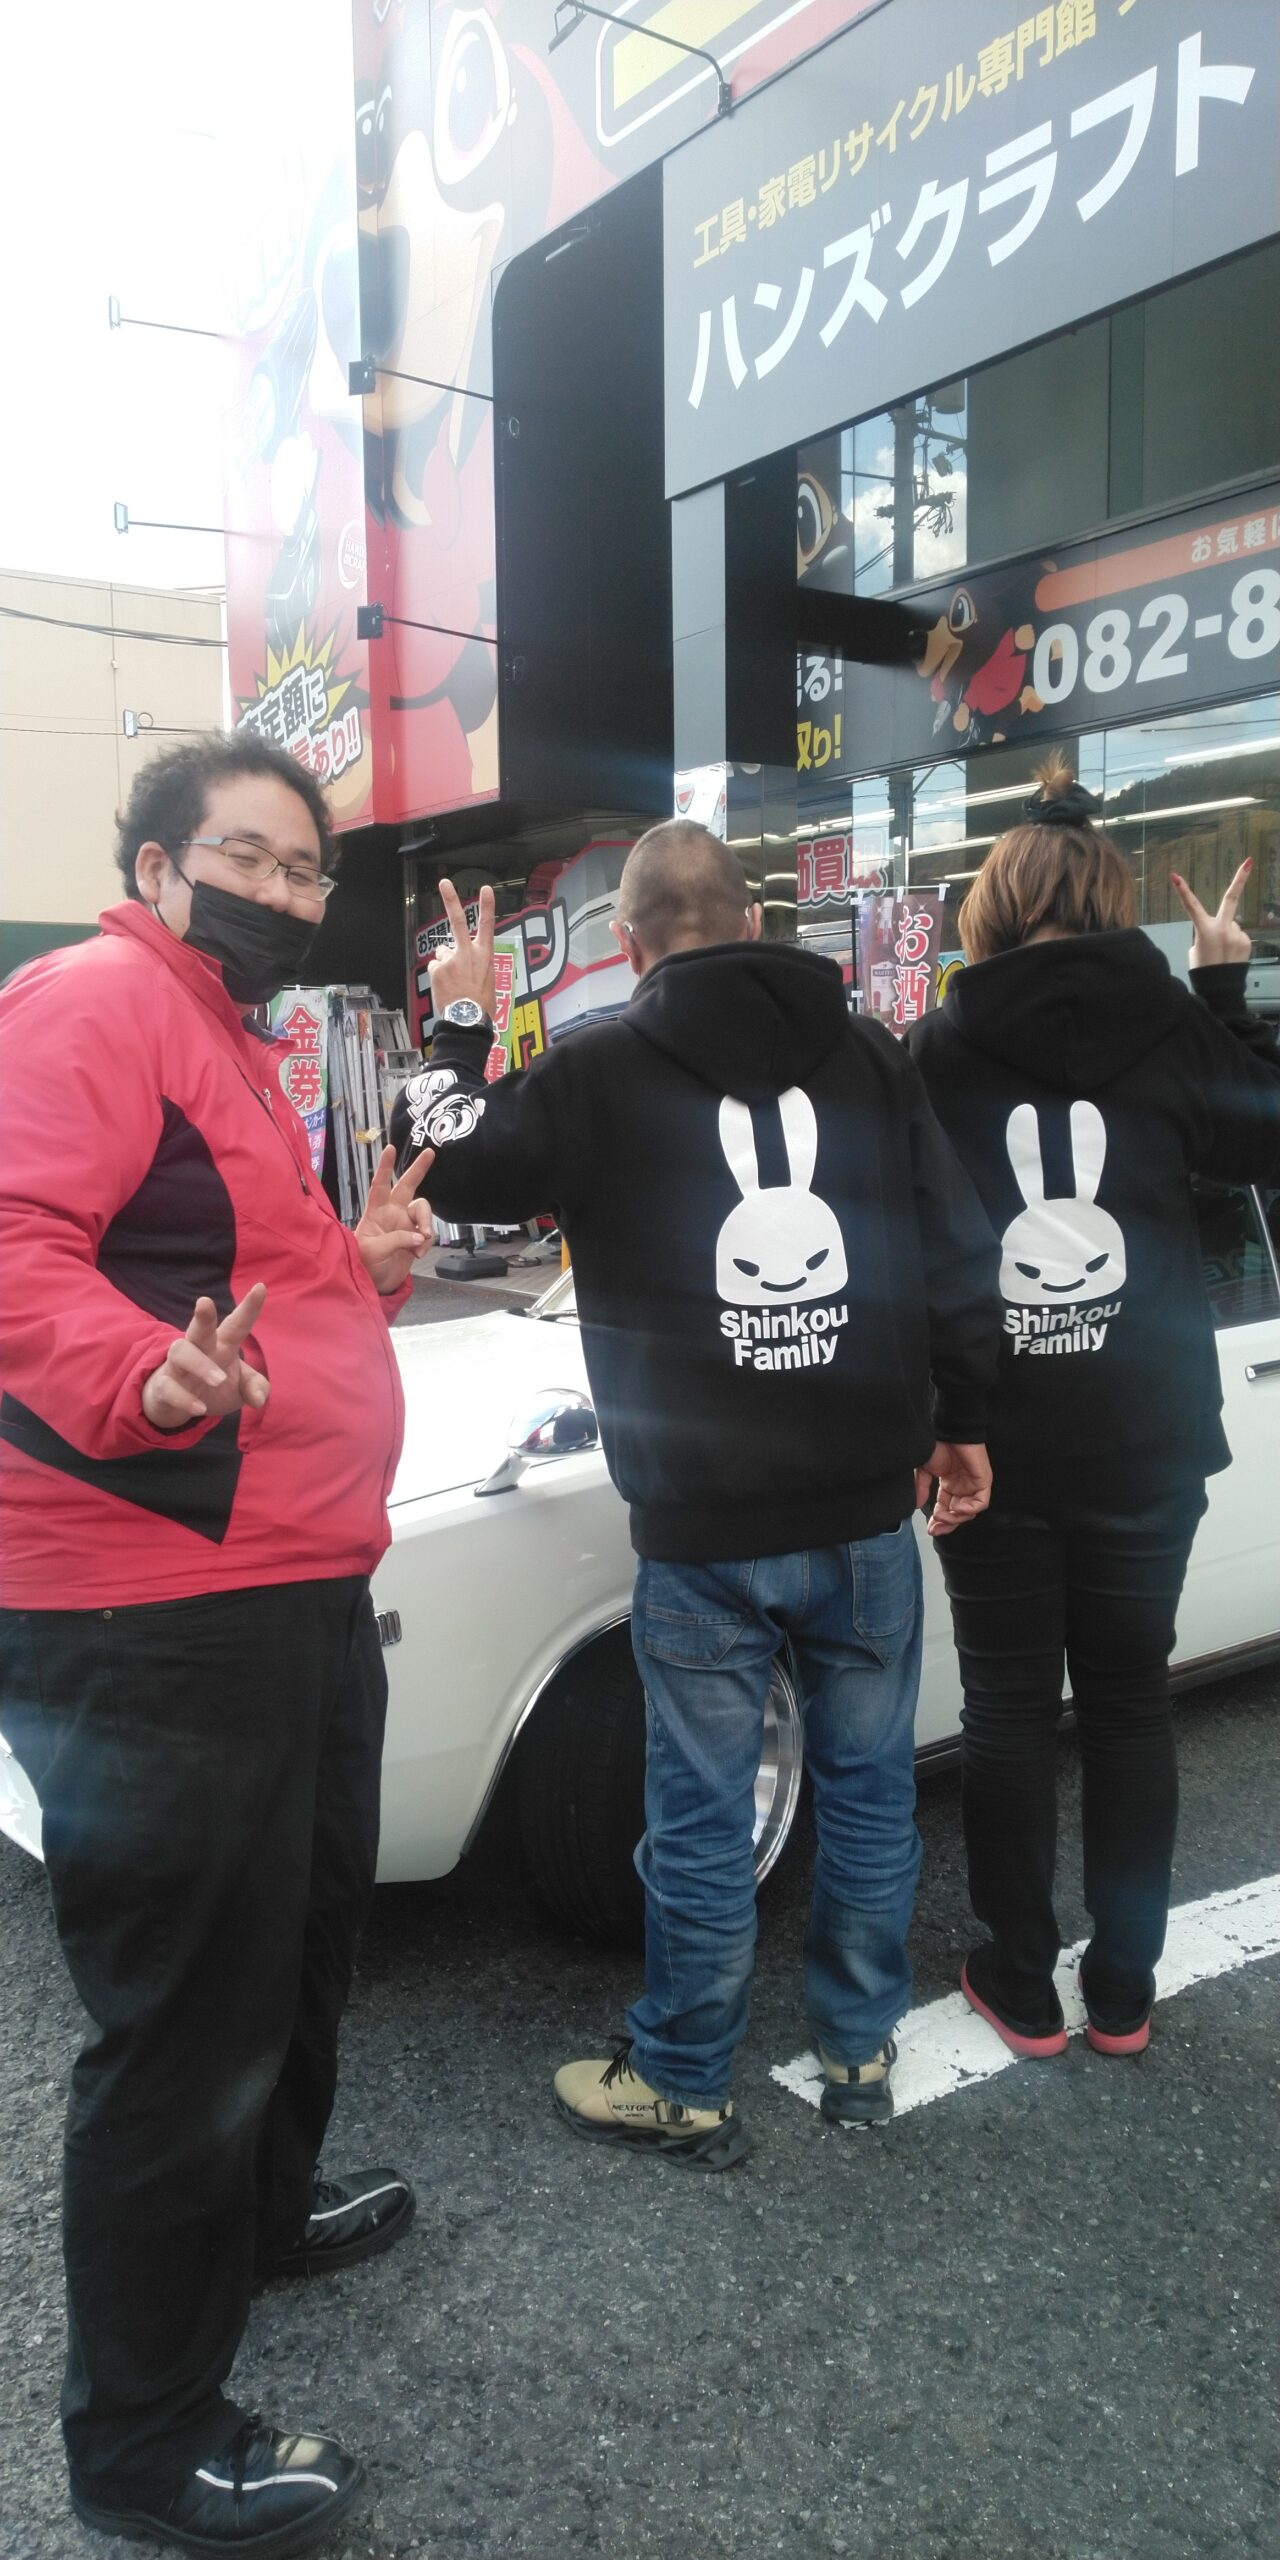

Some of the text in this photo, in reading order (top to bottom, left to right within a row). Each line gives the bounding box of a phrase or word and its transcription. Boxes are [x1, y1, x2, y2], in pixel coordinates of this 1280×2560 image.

[688, 31, 1256, 410] ハンズクラフト
[1032, 568, 1280, 704] 082-8
[894, 905, 934, 1024] お酒
[283, 1005, 322, 1112] 金券
[719, 1304, 849, 1339] Shinkou
[733, 1334, 839, 1371] Family
[1002, 1301, 1122, 1336] Shinkou
[1013, 1324, 1108, 1356] Family
